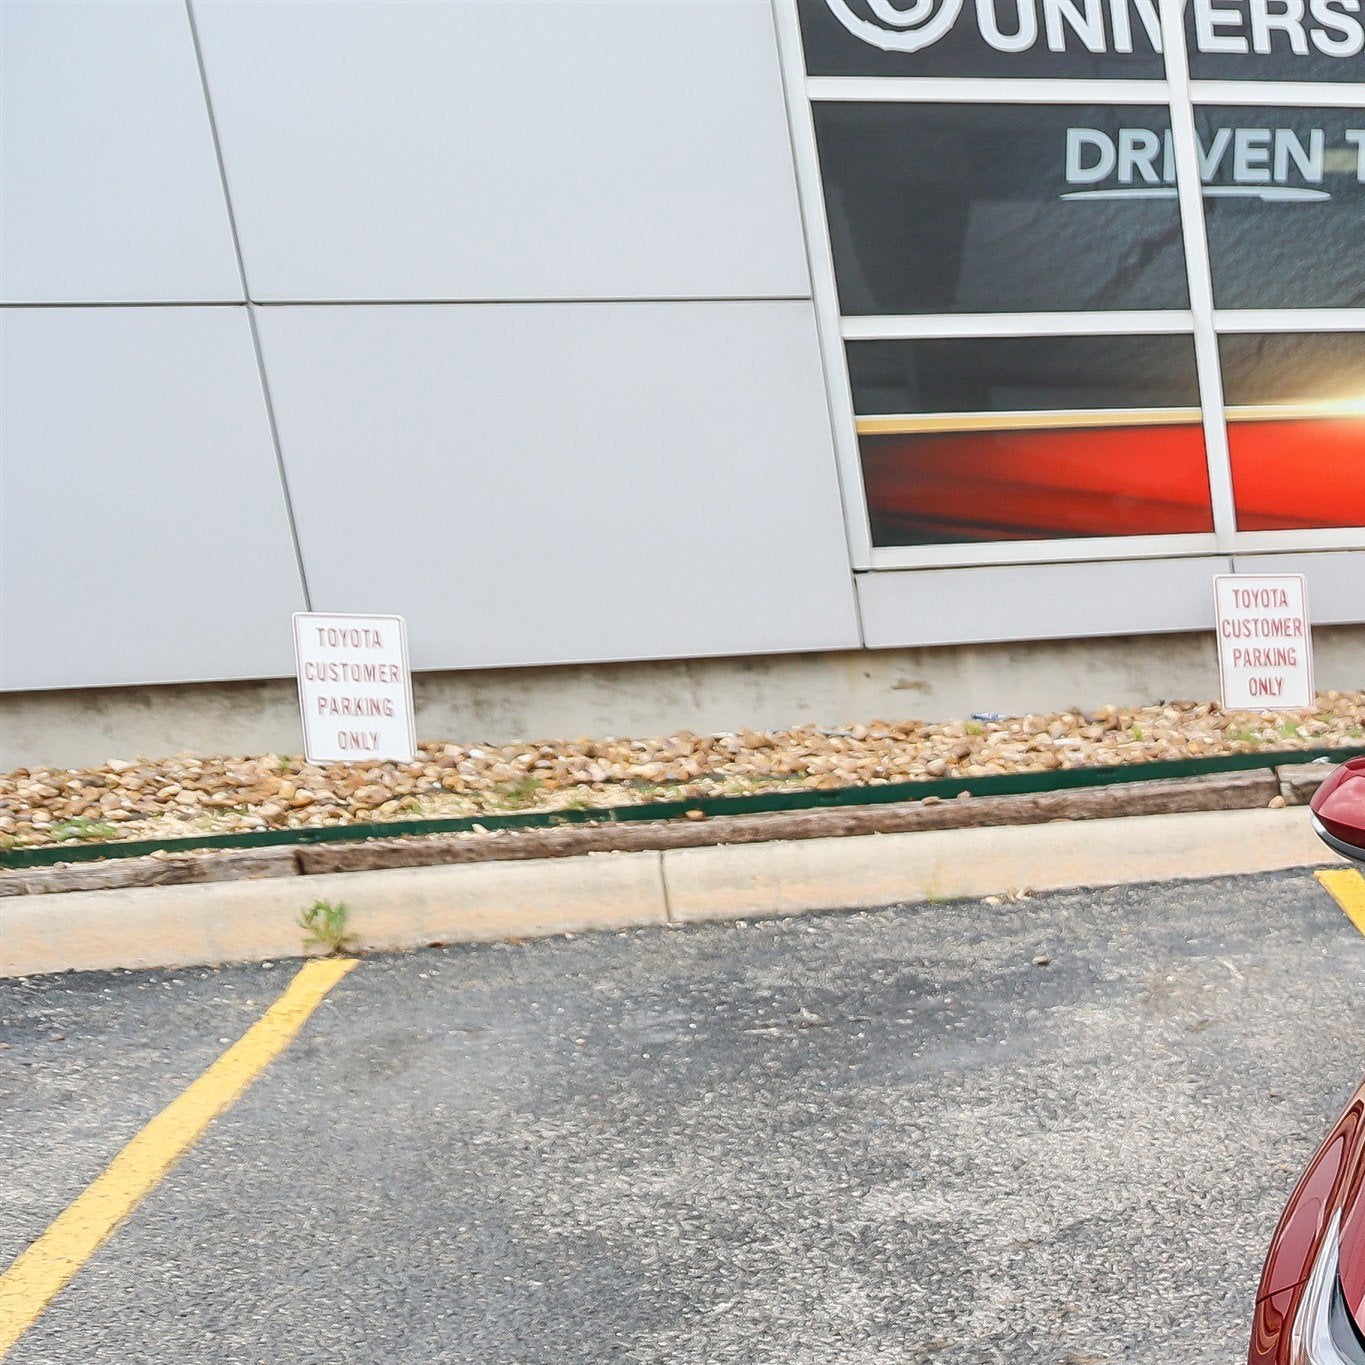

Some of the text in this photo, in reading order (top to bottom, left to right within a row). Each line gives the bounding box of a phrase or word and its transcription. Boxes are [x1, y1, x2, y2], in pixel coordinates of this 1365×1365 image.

[1065, 127, 1326, 185] DRIVEN
[1232, 588, 1288, 609] TOYOTA
[316, 626, 383, 649] TOYOTA
[1221, 617, 1303, 638] CUSTOMER
[1232, 646, 1298, 668] PARKING
[304, 661, 402, 683] CUSTOMER
[1248, 676, 1283, 697] ONLY
[317, 695, 395, 718] PARKING
[337, 730, 380, 751] ONLY
